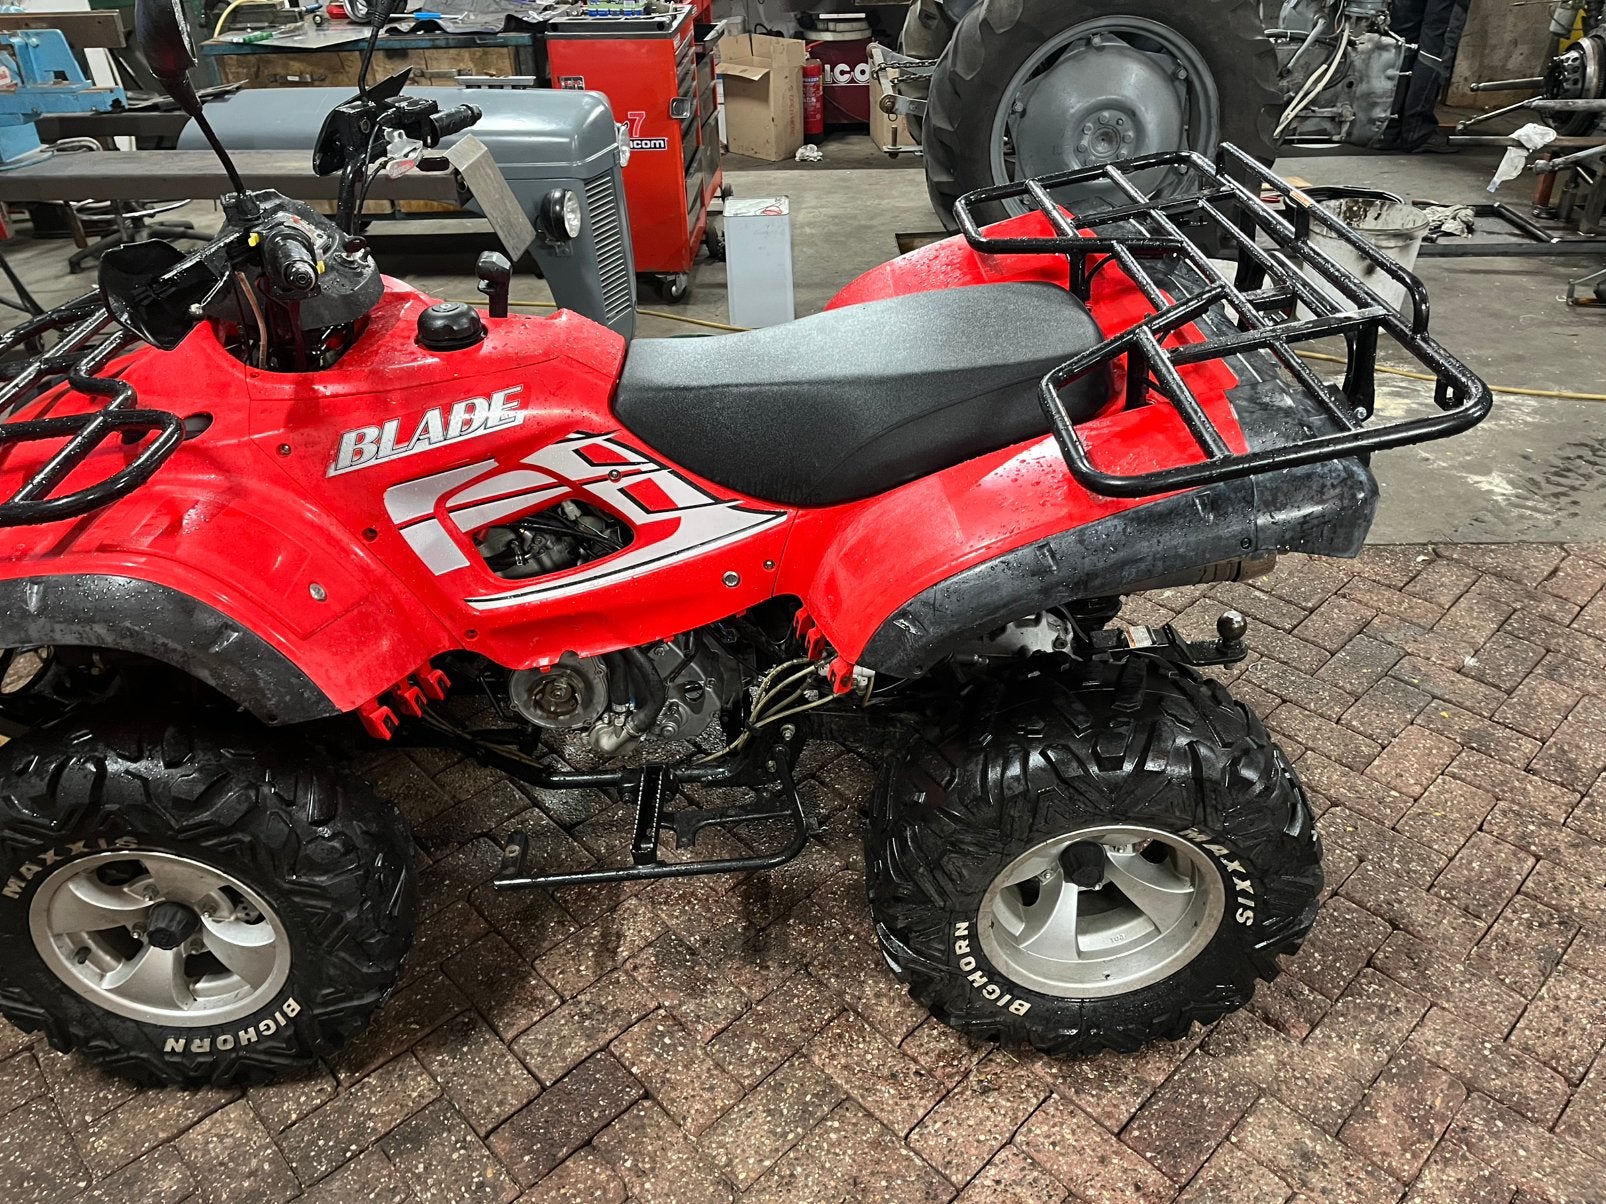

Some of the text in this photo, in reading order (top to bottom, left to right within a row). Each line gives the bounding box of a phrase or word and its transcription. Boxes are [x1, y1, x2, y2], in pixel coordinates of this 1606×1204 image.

[333, 383, 523, 471] BLADE
[1, 836, 139, 900] MAXXIS
[1178, 828, 1255, 927] MAXXIS
[955, 921, 1032, 1017] BIGHORN
[163, 996, 302, 1053] BIGHORN
